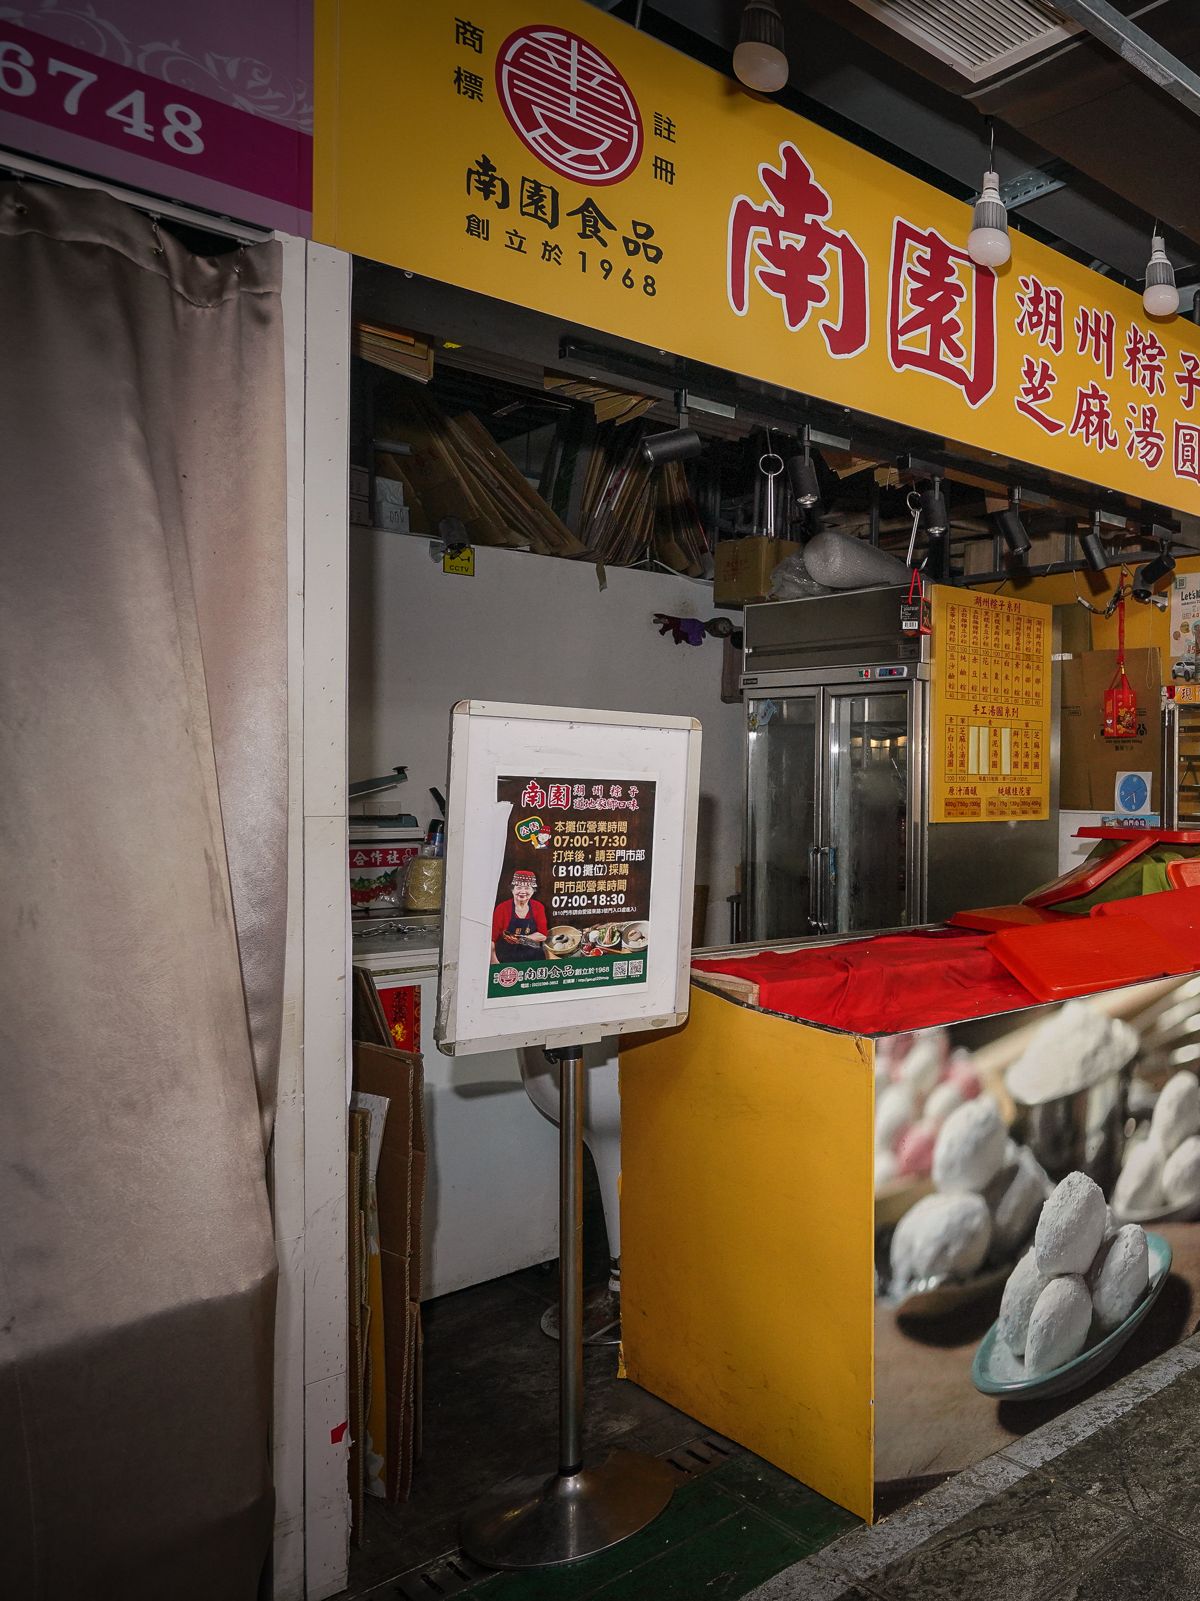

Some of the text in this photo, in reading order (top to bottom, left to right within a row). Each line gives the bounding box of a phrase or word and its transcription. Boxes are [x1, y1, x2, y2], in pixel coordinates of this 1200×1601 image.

[0, 40, 205, 156] 6748
[453, 17, 485, 104] 商標
[652, 112, 677, 187] 註冊
[465, 154, 664, 266] 南園食品
[464, 213, 659, 298] 創立於1968
[727, 140, 998, 410] 南園
[520, 780, 572, 810] 南園
[553, 835, 627, 848] 07:00-17:30
[552, 894, 626, 908] 07:00-18:30
[554, 880, 627, 893] 門市部營業時間
